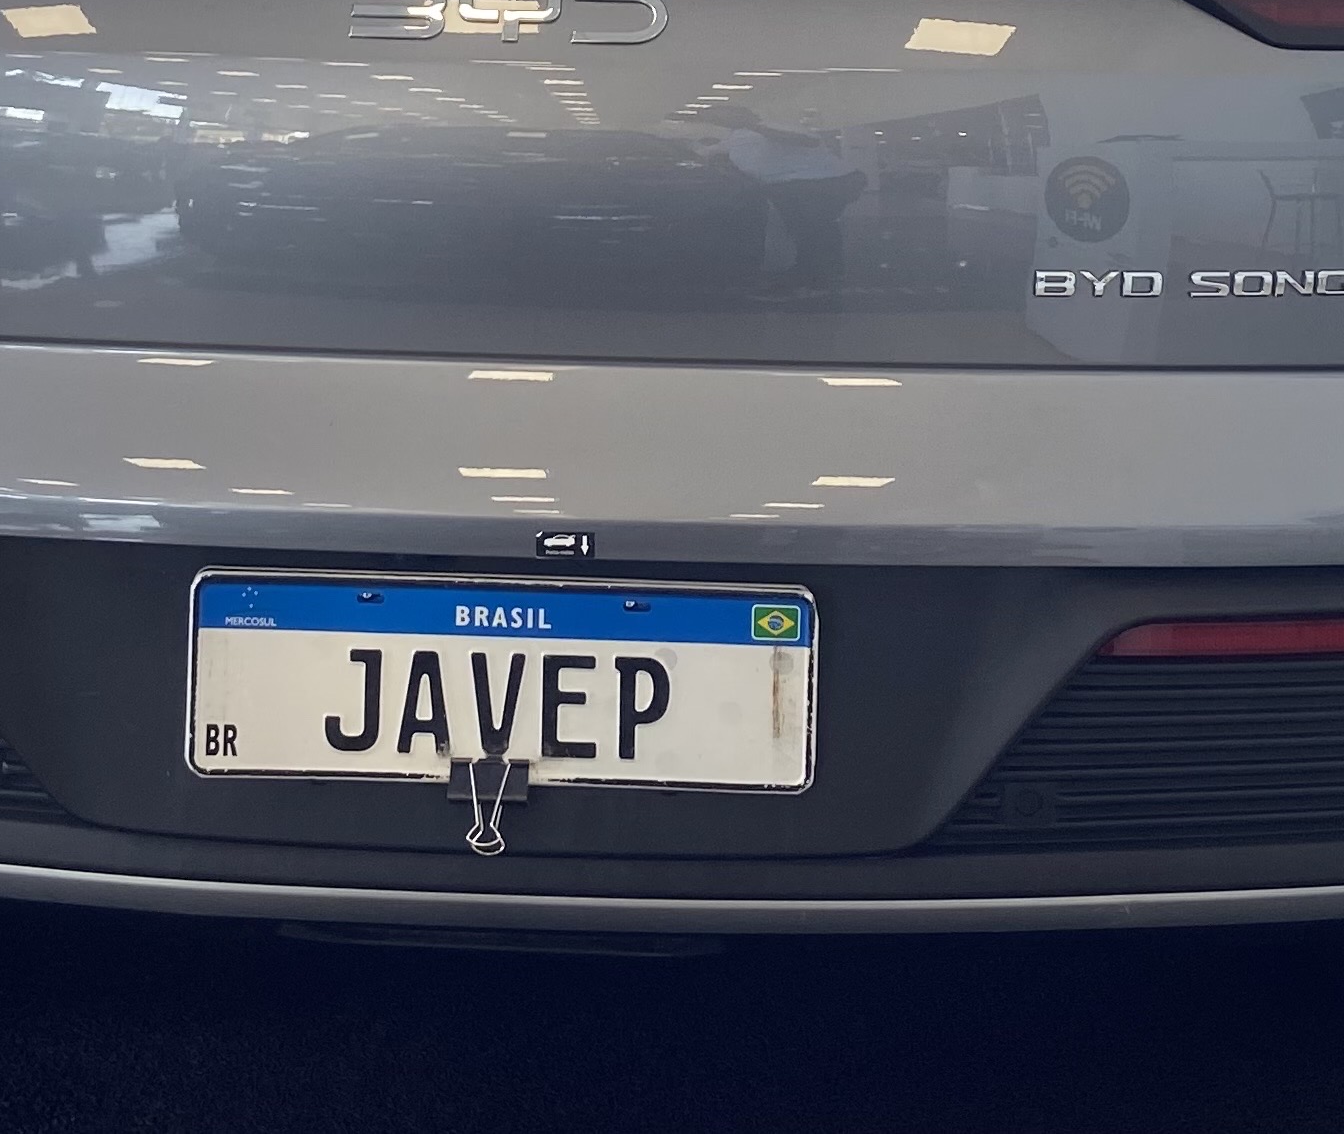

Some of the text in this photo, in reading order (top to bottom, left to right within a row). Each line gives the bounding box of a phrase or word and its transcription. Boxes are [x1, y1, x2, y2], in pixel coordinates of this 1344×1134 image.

[1033, 269, 1163, 298] BYD
[225, 616, 277, 627] MERCOSUL
[455, 605, 552, 630] BRASIL
[324, 648, 672, 760] JAVEP
[205, 724, 238, 757] BR
